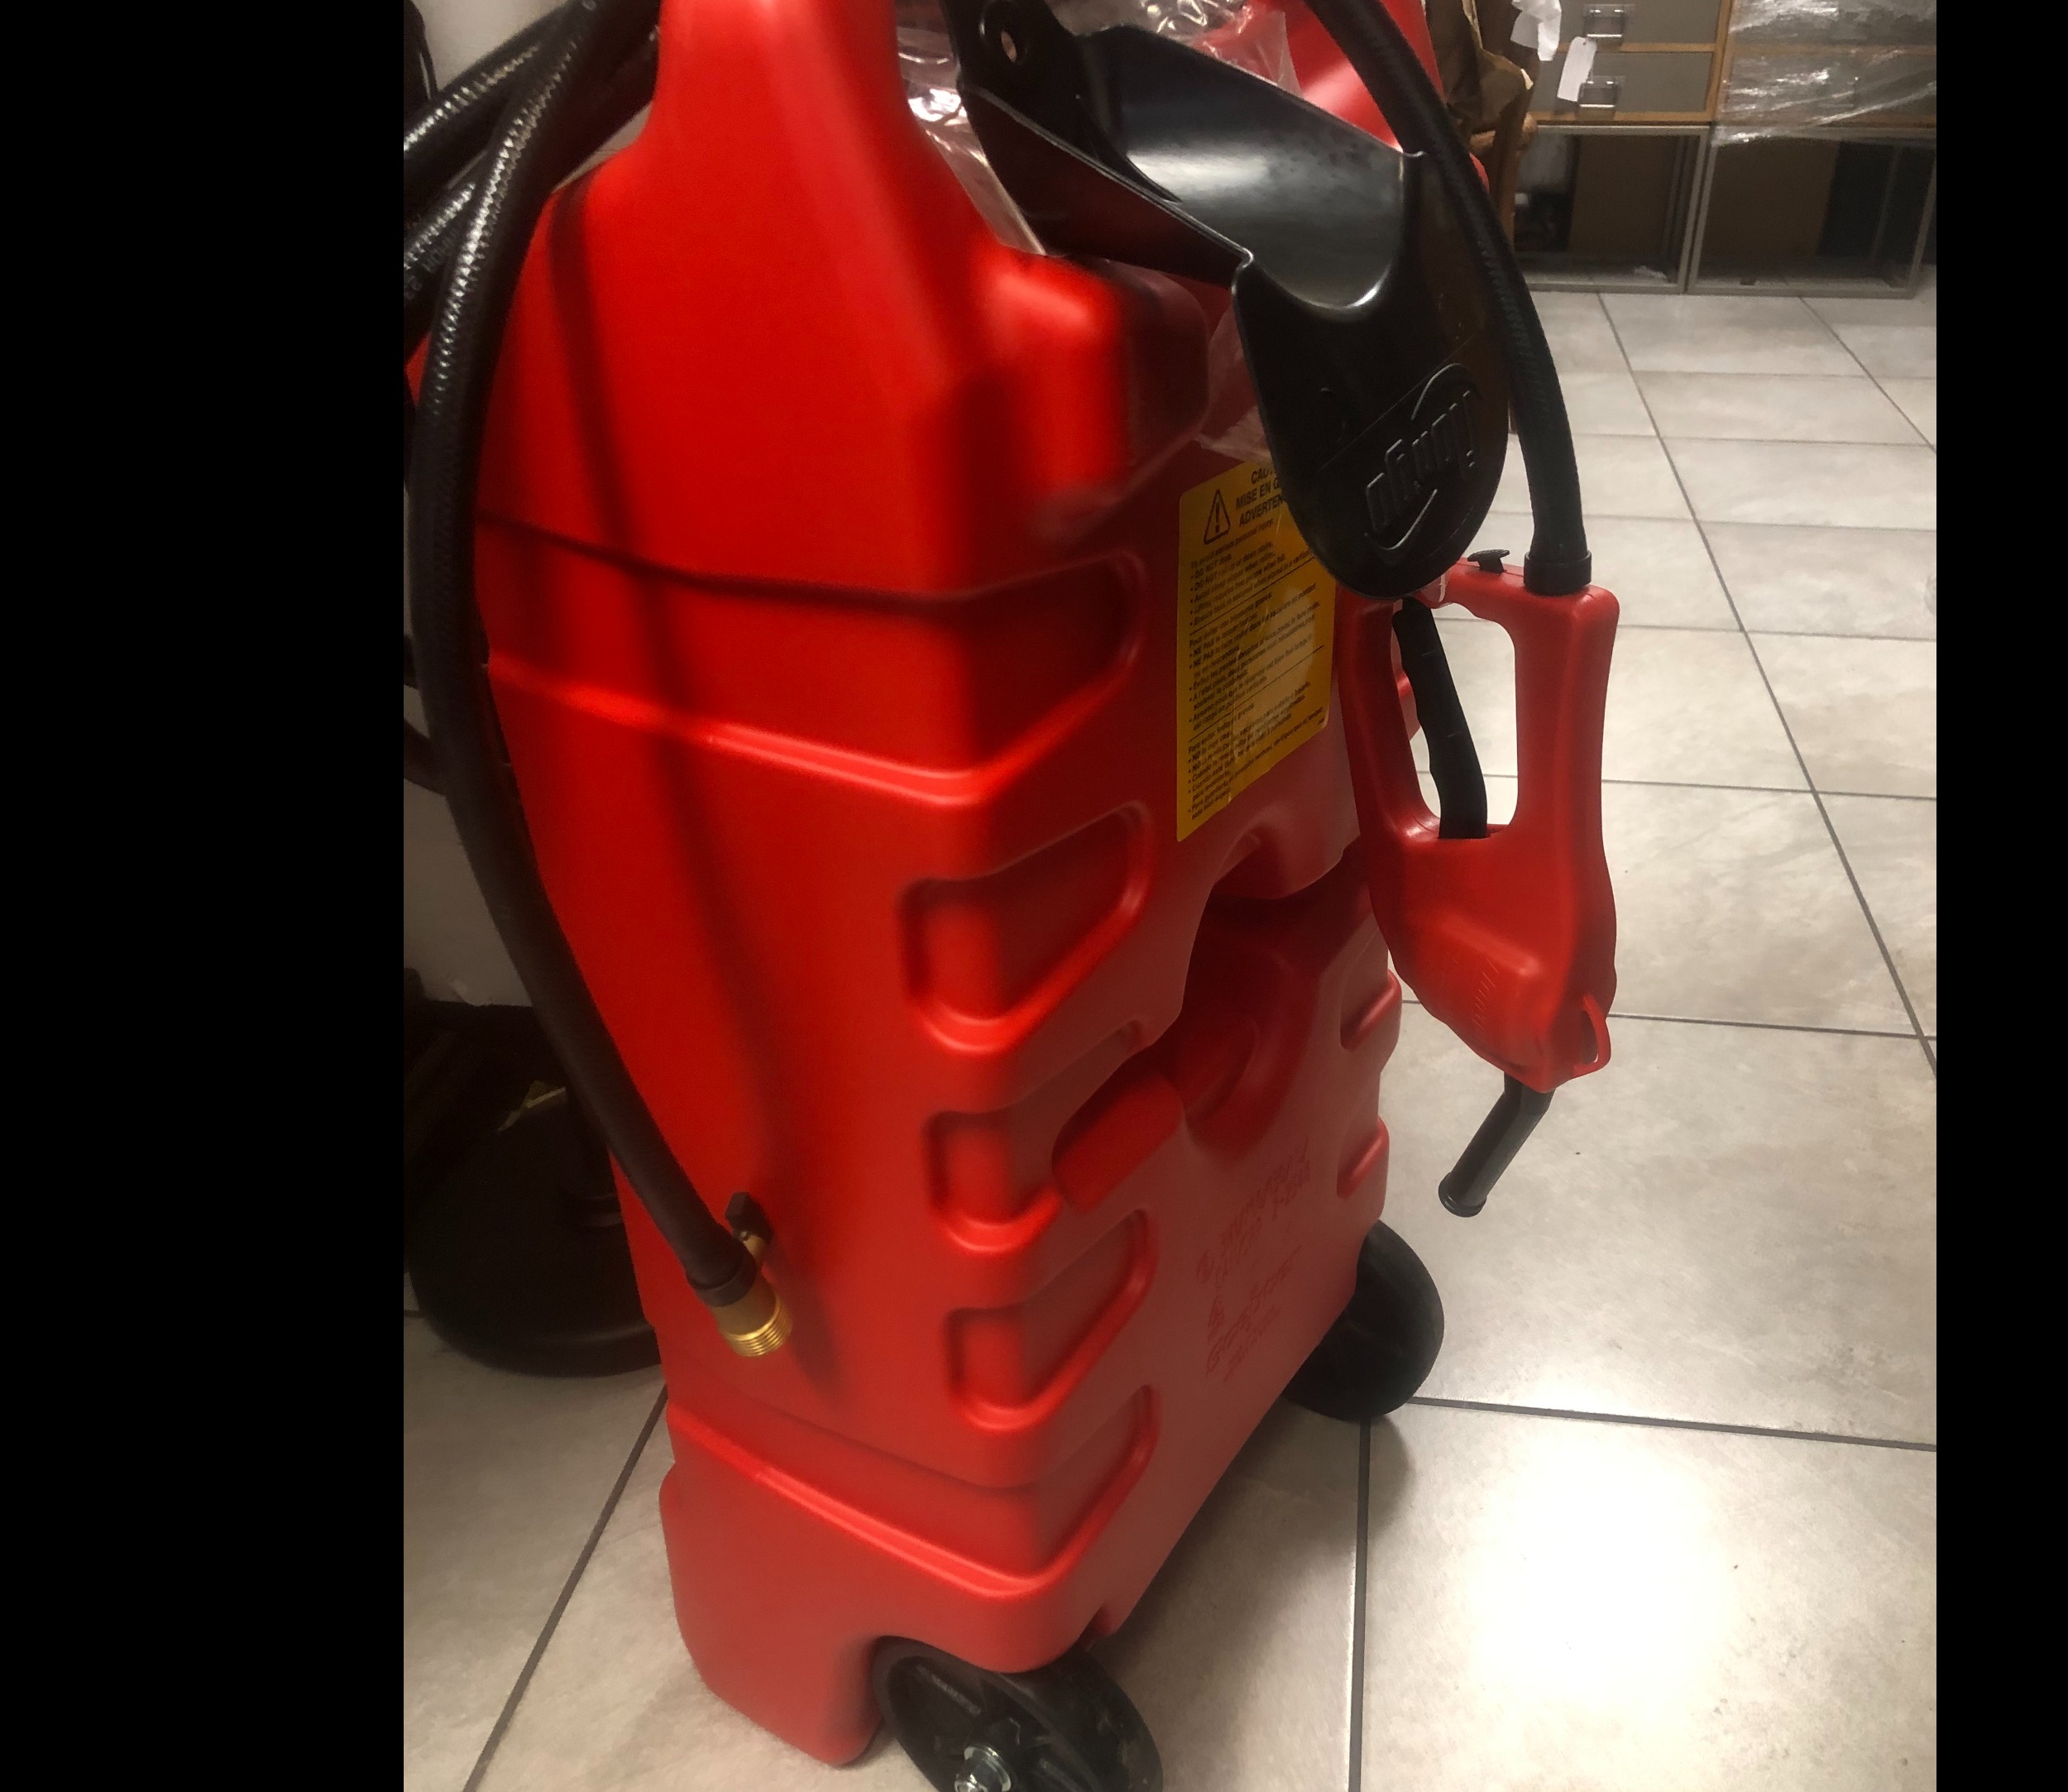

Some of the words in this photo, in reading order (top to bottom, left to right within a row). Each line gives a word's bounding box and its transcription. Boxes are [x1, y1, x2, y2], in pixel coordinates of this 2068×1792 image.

[1236, 489, 1257, 510] MISE
[1260, 482, 1271, 497] EN
[1239, 493, 1284, 527] ADVERTEN
